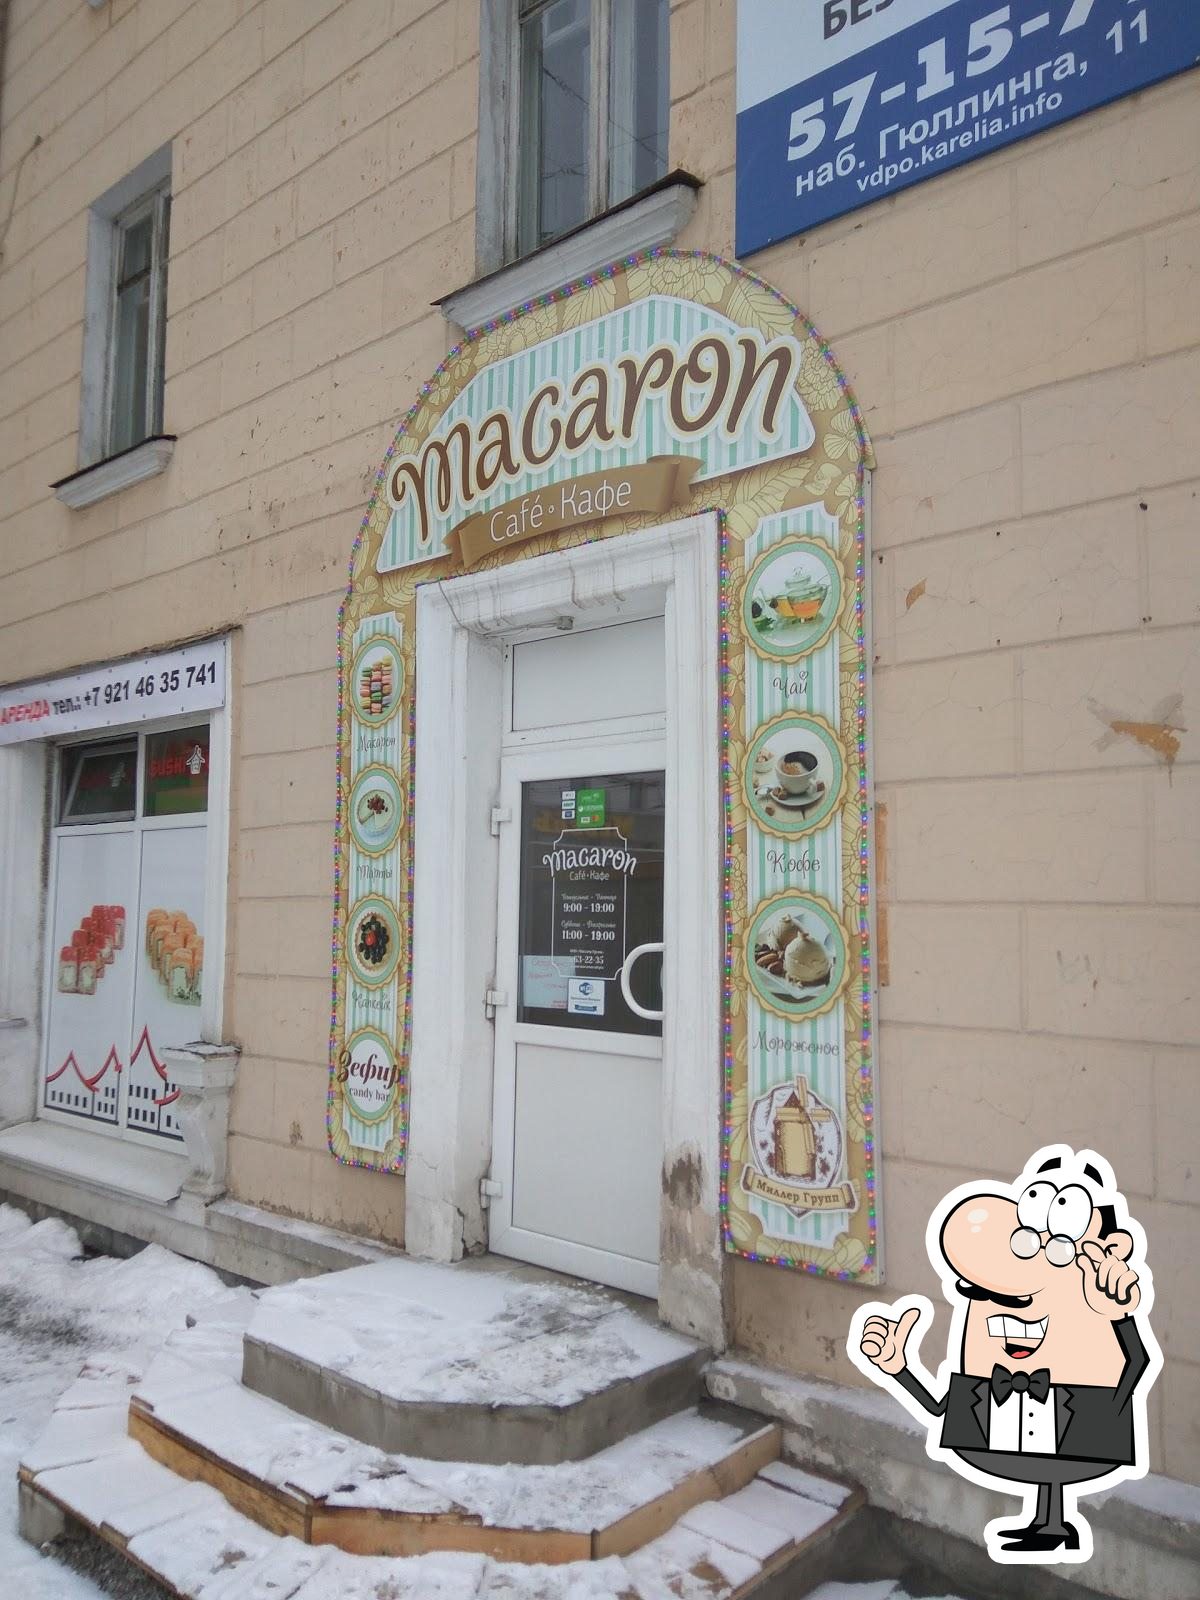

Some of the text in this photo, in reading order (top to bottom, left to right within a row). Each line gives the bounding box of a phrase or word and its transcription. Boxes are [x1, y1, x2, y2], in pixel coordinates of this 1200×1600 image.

[796, 9, 1148, 197] наб. Гюллинга, 11
[856, 92, 1063, 192] vdpo.karelia.info
[490, 480, 632, 542] Café Кафе
[85, 687, 100, 706] +7
[105, 680, 130, 704] 921
[136, 675, 154, 697] 46
[160, 670, 179, 692] 35
[186, 661, 215, 688] 741
[773, 671, 808, 698] Чай
[569, 871, 585, 880] Café
[767, 850, 821, 879] Кофе
[563, 903, 582, 913] 9:00
[562, 930, 583, 940] 11:00
[591, 930, 615, 941] 19:00
[752, 1031, 840, 1056] Мороженое
[337, 1050, 401, 1090] Зефир
[349, 1087, 391, 1102] candy bar
[756, 1179, 840, 1206] Миллер Групп
